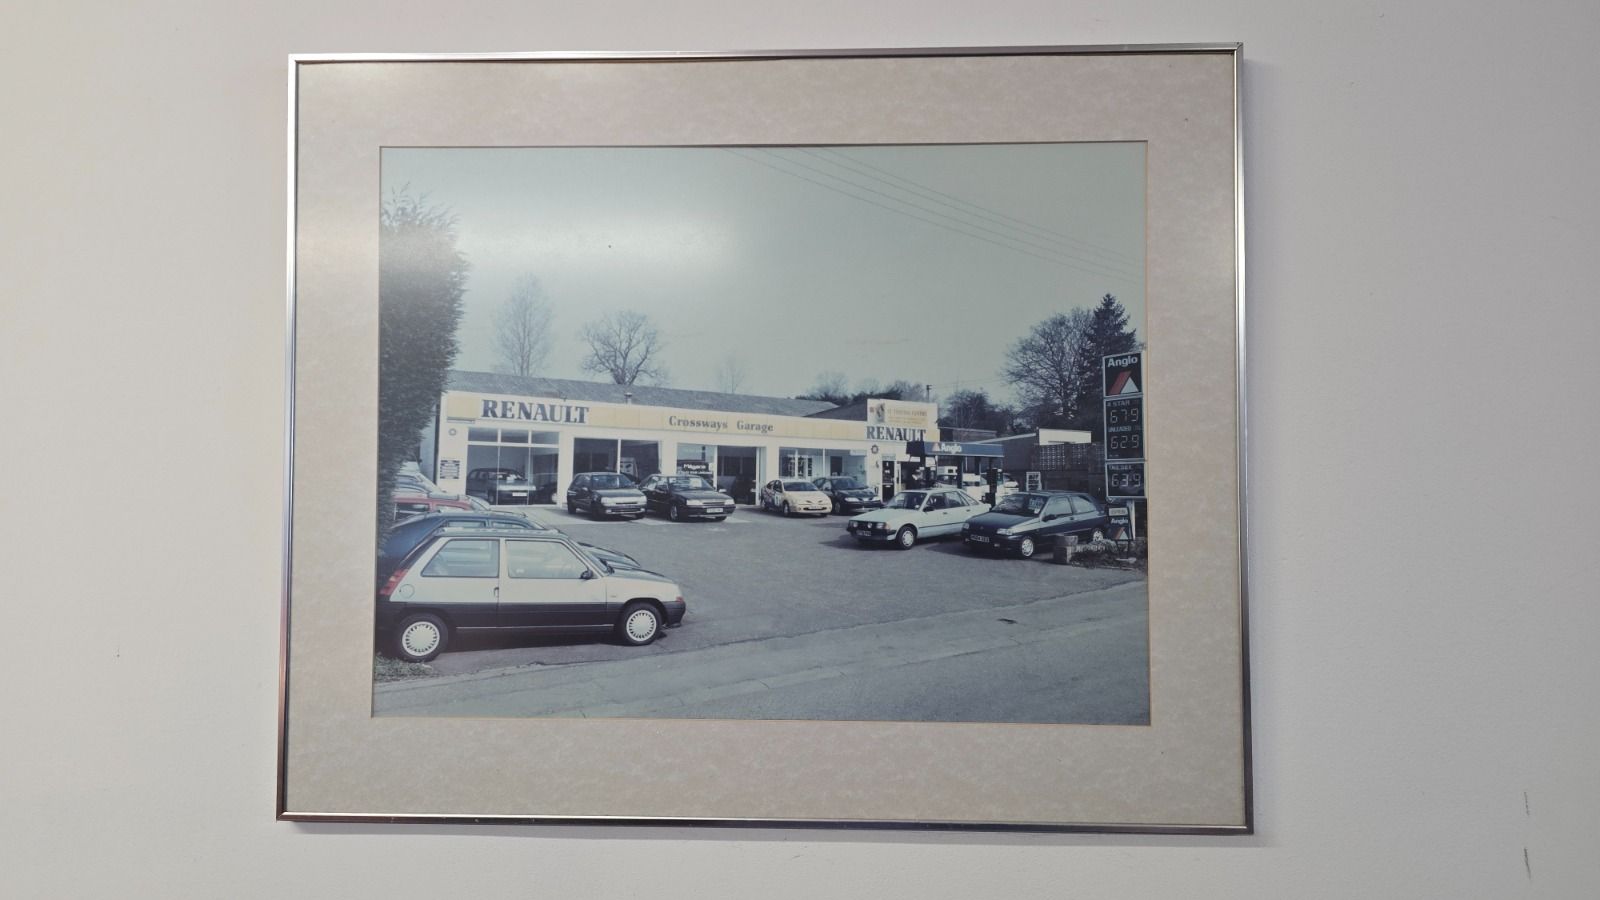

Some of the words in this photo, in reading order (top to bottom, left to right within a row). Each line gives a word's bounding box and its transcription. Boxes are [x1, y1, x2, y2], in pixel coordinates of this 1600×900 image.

[1107, 355, 1138, 368] Anglo
[481, 399, 589, 424] RENAULT
[668, 415, 728, 432] Crossways
[736, 421, 774, 434] Garage
[866, 426, 926, 442] RENAULT
[941, 442, 962, 454] Anglo
